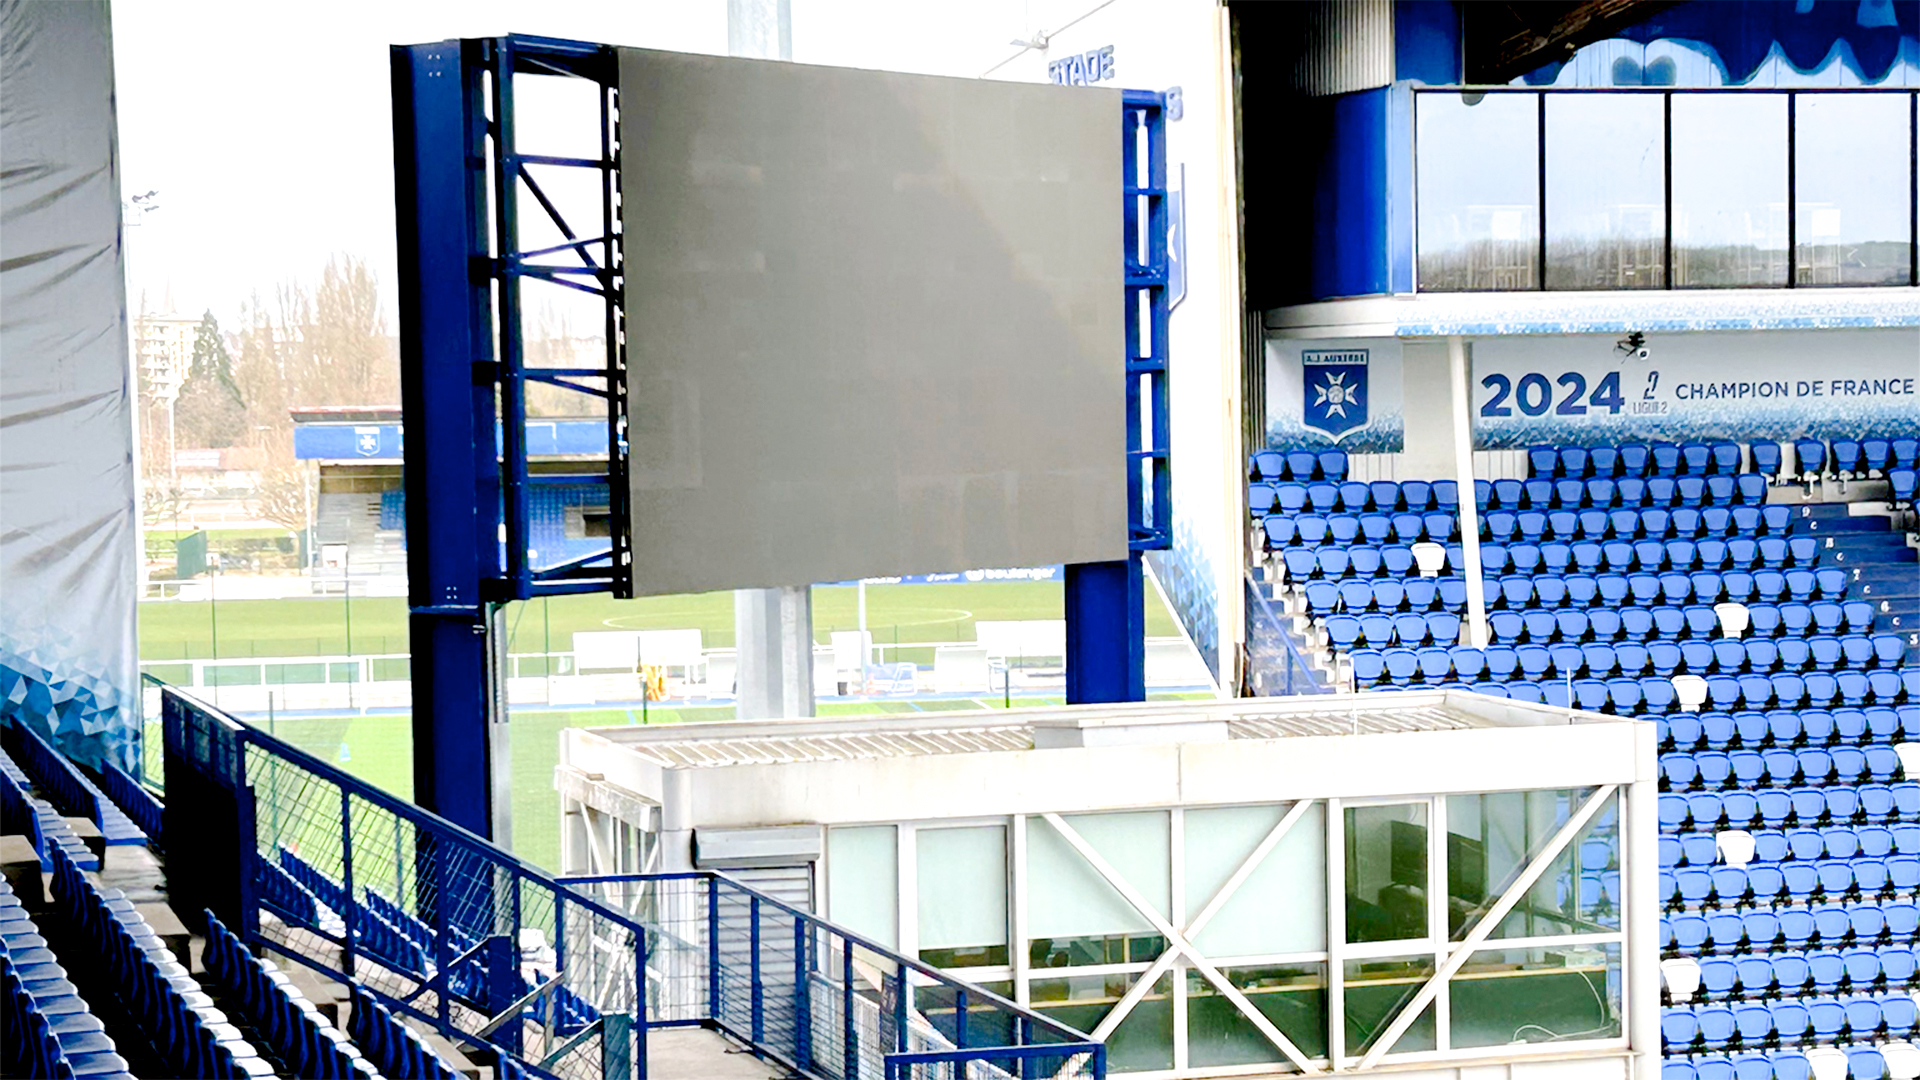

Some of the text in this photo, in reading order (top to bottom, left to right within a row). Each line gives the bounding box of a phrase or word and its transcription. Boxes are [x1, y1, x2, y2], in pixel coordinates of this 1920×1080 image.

[1480, 371, 1625, 417] 2024
[1675, 378, 1914, 400] CHAMPION DE FRANCE
